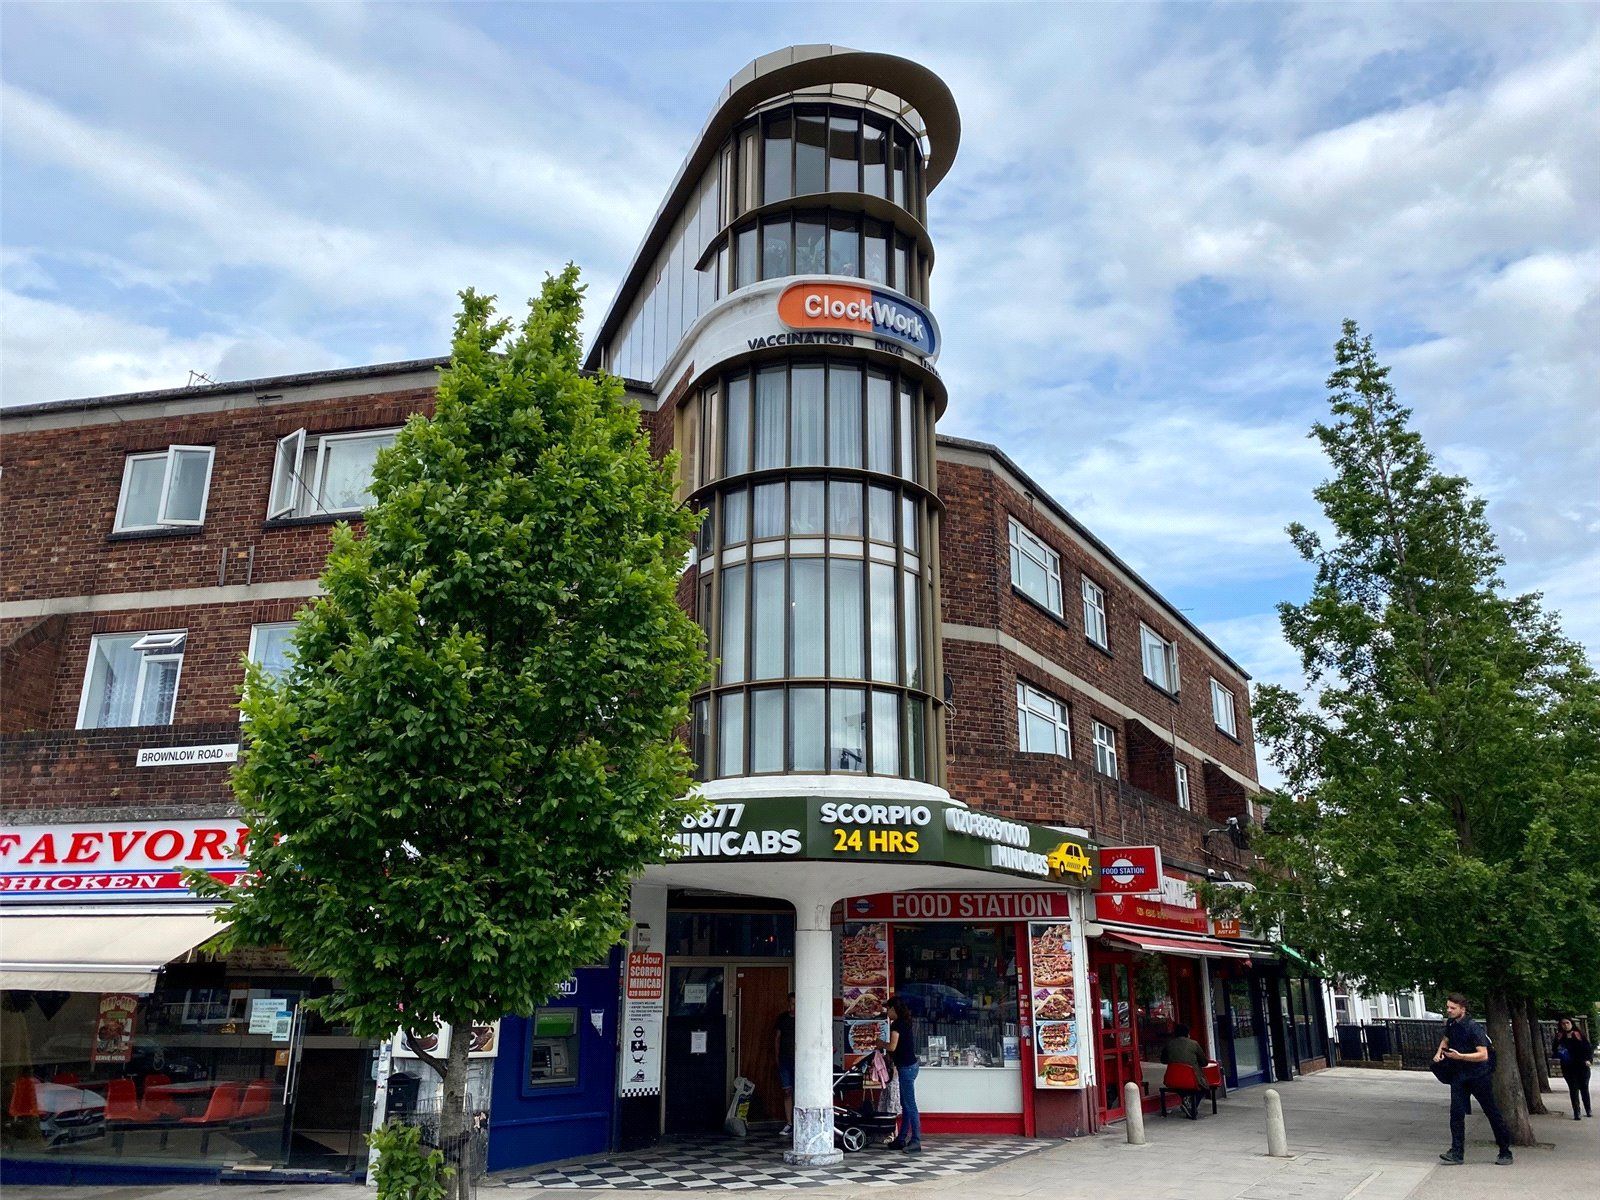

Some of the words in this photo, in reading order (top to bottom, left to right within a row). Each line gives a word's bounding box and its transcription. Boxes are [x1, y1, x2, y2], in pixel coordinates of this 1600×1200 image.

[804, 294, 924, 341] ClockWork
[747, 332, 854, 351] VACCINATION
[142, 750, 195, 762] BROWNLOW
[197, 748, 224, 760] ROAD
[820, 802, 932, 826] SCORPIO
[659, 829, 801, 857] MINICABS
[833, 829, 862, 851] 24
[868, 830, 920, 853] HRS
[991, 844, 1049, 876] MINICABS
[1102, 867, 1119, 875] FOOD
[1119, 866, 1145, 875] STATION
[0, 874, 163, 890] HICKEN
[892, 894, 952, 917] FOOD
[959, 894, 1052, 917] STATION
[631, 955, 641, 964] 24
[642, 954, 661, 964] Hour
[630, 965, 662, 978] SCORPIO
[554, 980, 571, 991] ash
[629, 978, 661, 989] MINICAB
